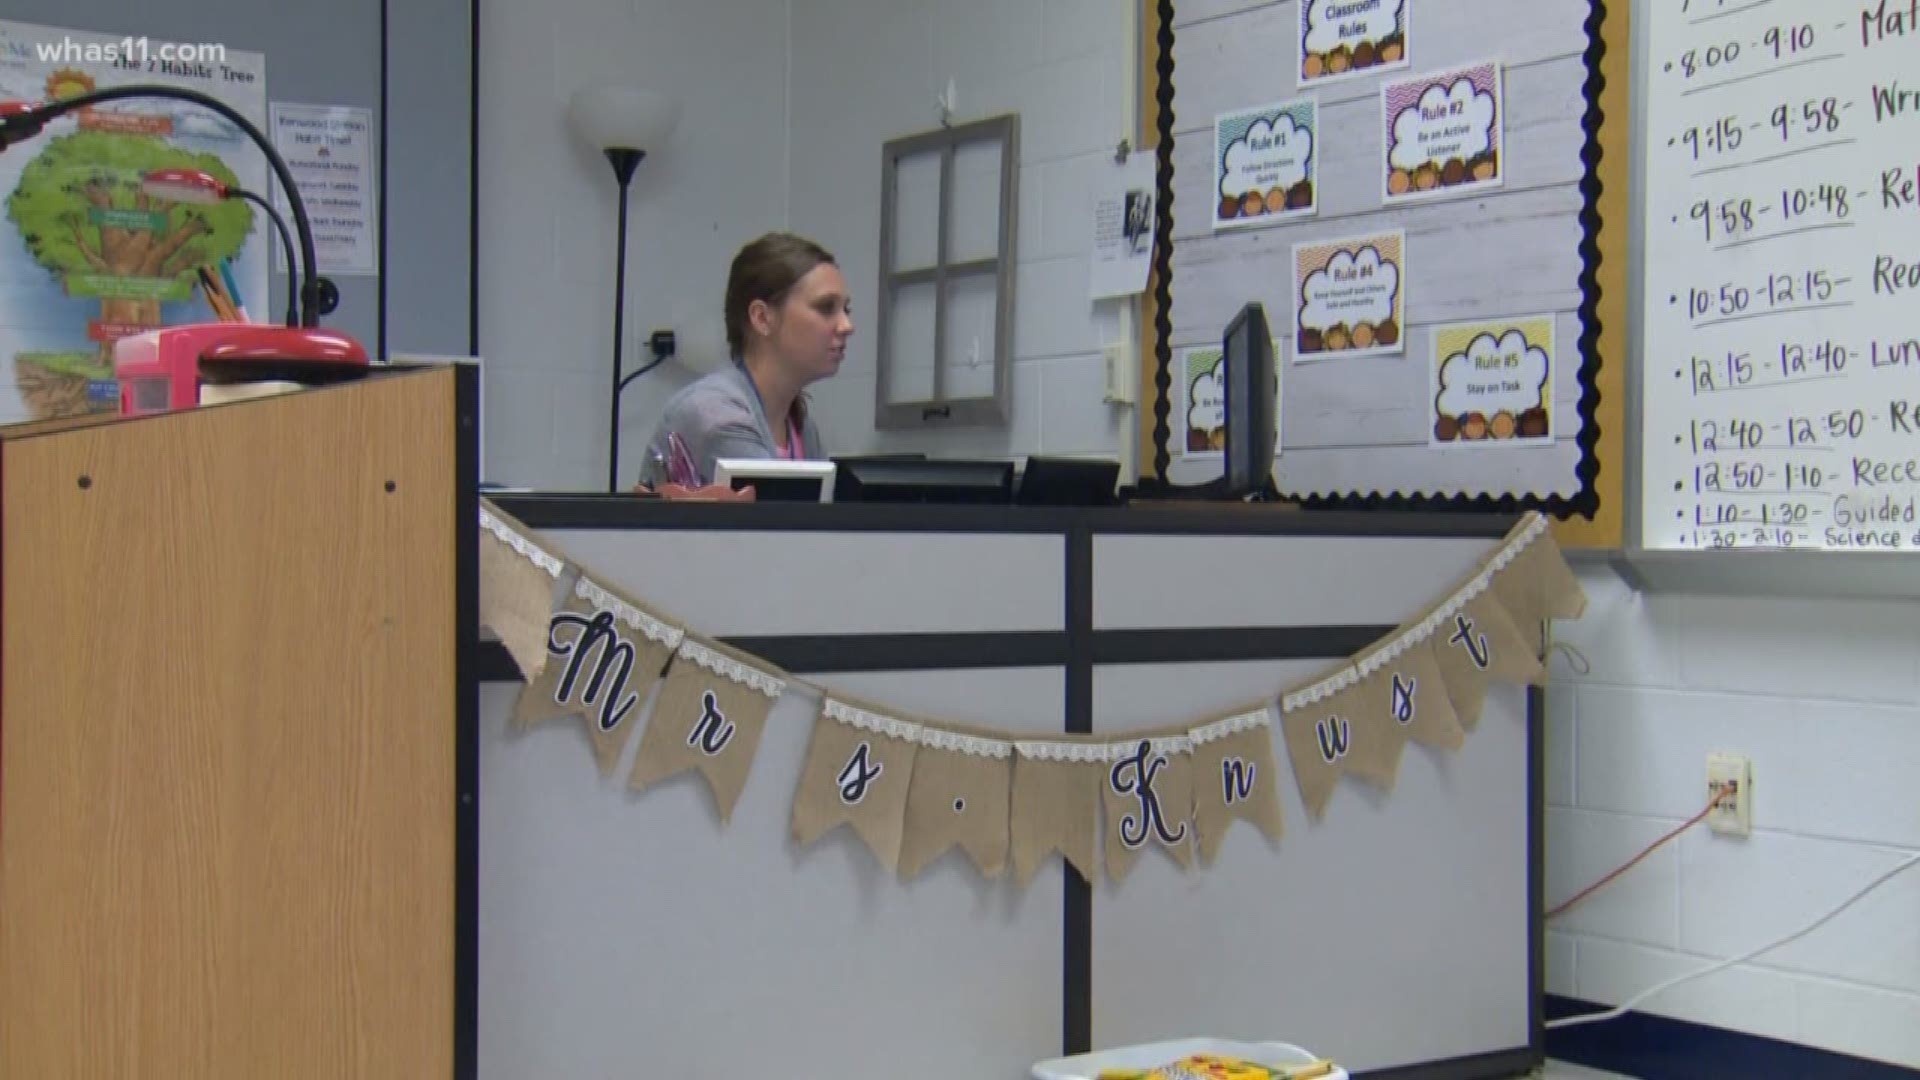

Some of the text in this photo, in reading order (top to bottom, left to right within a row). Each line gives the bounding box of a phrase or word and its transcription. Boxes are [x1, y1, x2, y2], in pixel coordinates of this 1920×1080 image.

[1326, 0, 1380, 20] Classroom
[1338, 21, 1367, 38] Rules
[161, 59, 212, 79] Habits
[220, 64, 255, 82] Tree
[1422, 100, 1464, 121] Rule #2
[1443, 125, 1470, 137] Active
[1250, 132, 1286, 151] Rule #1
[1335, 264, 1373, 282] Rule #4
[1475, 353, 1518, 371] Rule #5
[1466, 380, 1519, 396] Stay on Task
[1833, 493, 1915, 528] Guided
[1825, 526, 1900, 548] Science
